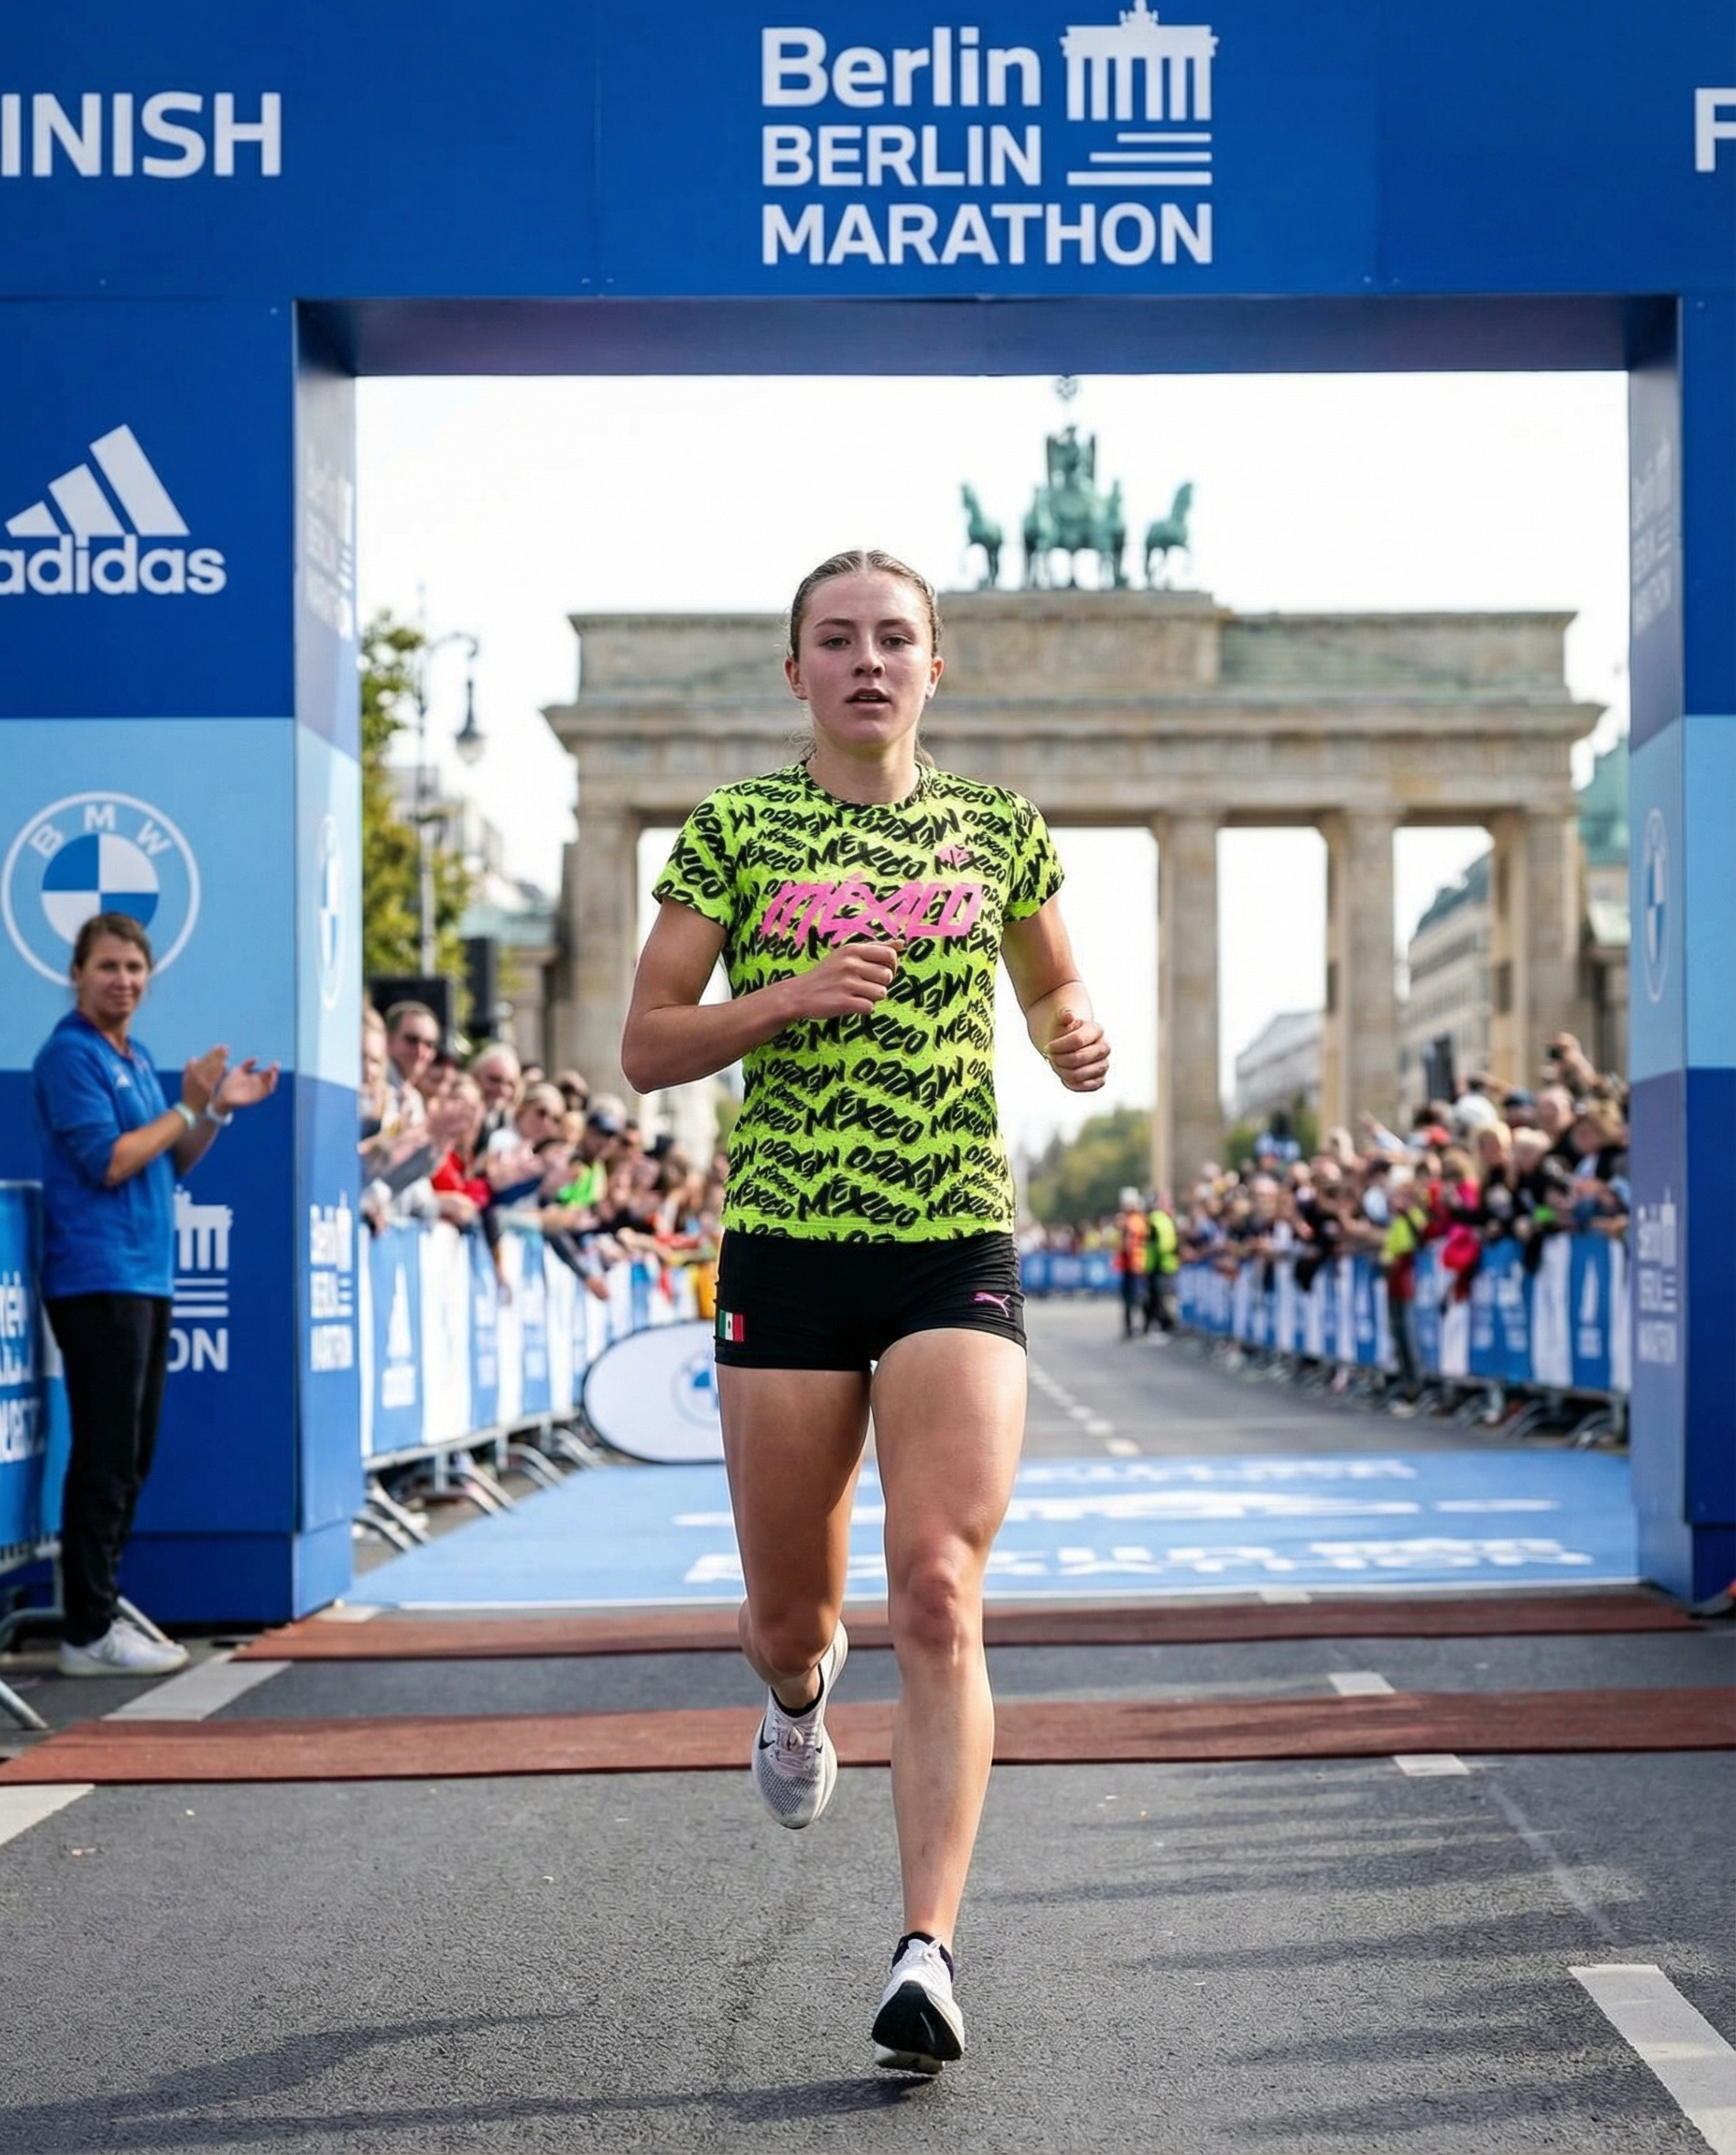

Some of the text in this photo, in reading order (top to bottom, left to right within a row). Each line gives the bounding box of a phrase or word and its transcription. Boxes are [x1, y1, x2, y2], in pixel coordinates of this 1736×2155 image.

[761, 26, 1042, 108] Berlin
[0, 91, 281, 178] INISH
[761, 124, 1042, 186] BERLIN
[1694, 86, 1736, 173] F
[761, 202, 1213, 265] MARATHON
[0, 534, 227, 596] adidas
[28, 803, 172, 860] BMW
